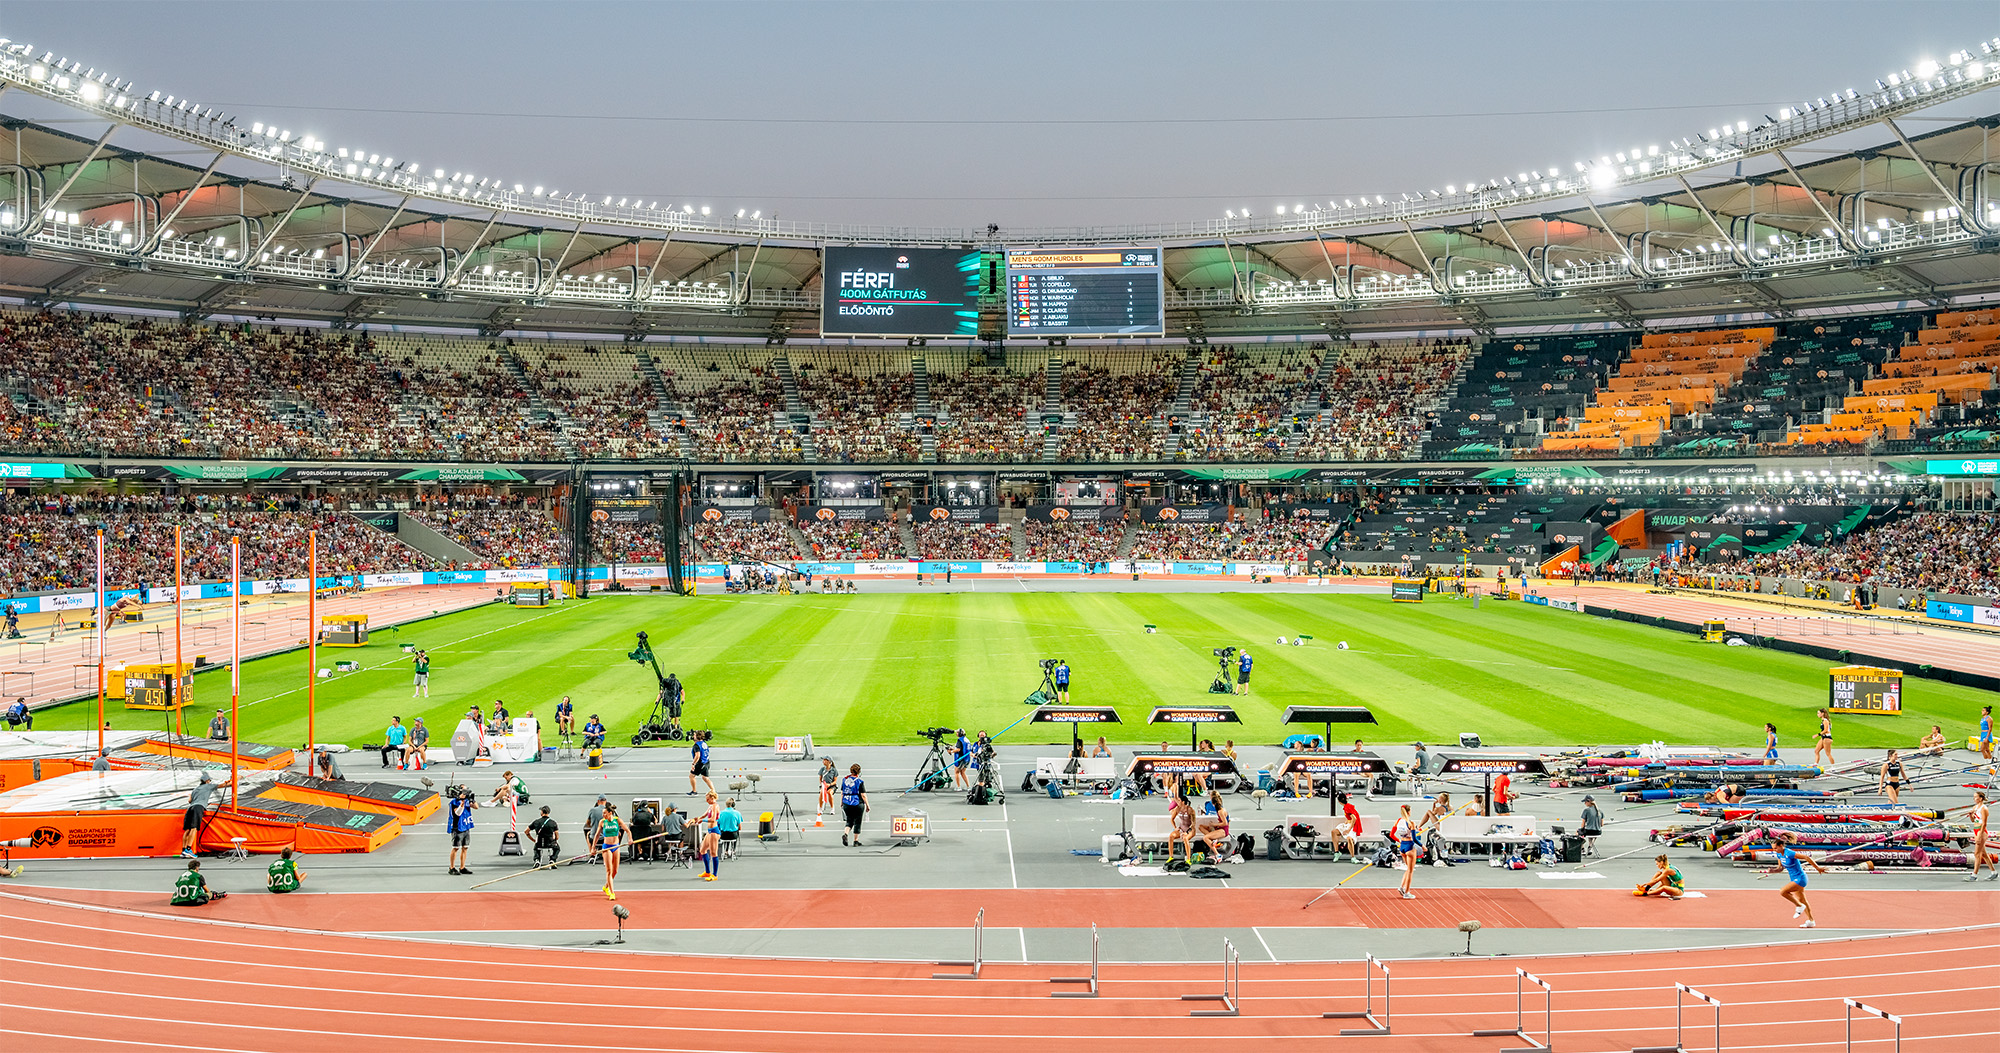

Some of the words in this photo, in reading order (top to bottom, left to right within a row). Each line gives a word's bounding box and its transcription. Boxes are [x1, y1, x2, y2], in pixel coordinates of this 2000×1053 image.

[841, 268, 894, 288] FÉRFI
[840, 289, 871, 299] 400M
[873, 288, 927, 300] GÁTFUTÁS
[839, 305, 894, 316] ELŐDÖNTŐ
[1834, 682, 1854, 691] HOLM
[145, 690, 165, 705] 4.50
[1865, 693, 1882, 709] 15
[895, 822, 906, 831] 60
